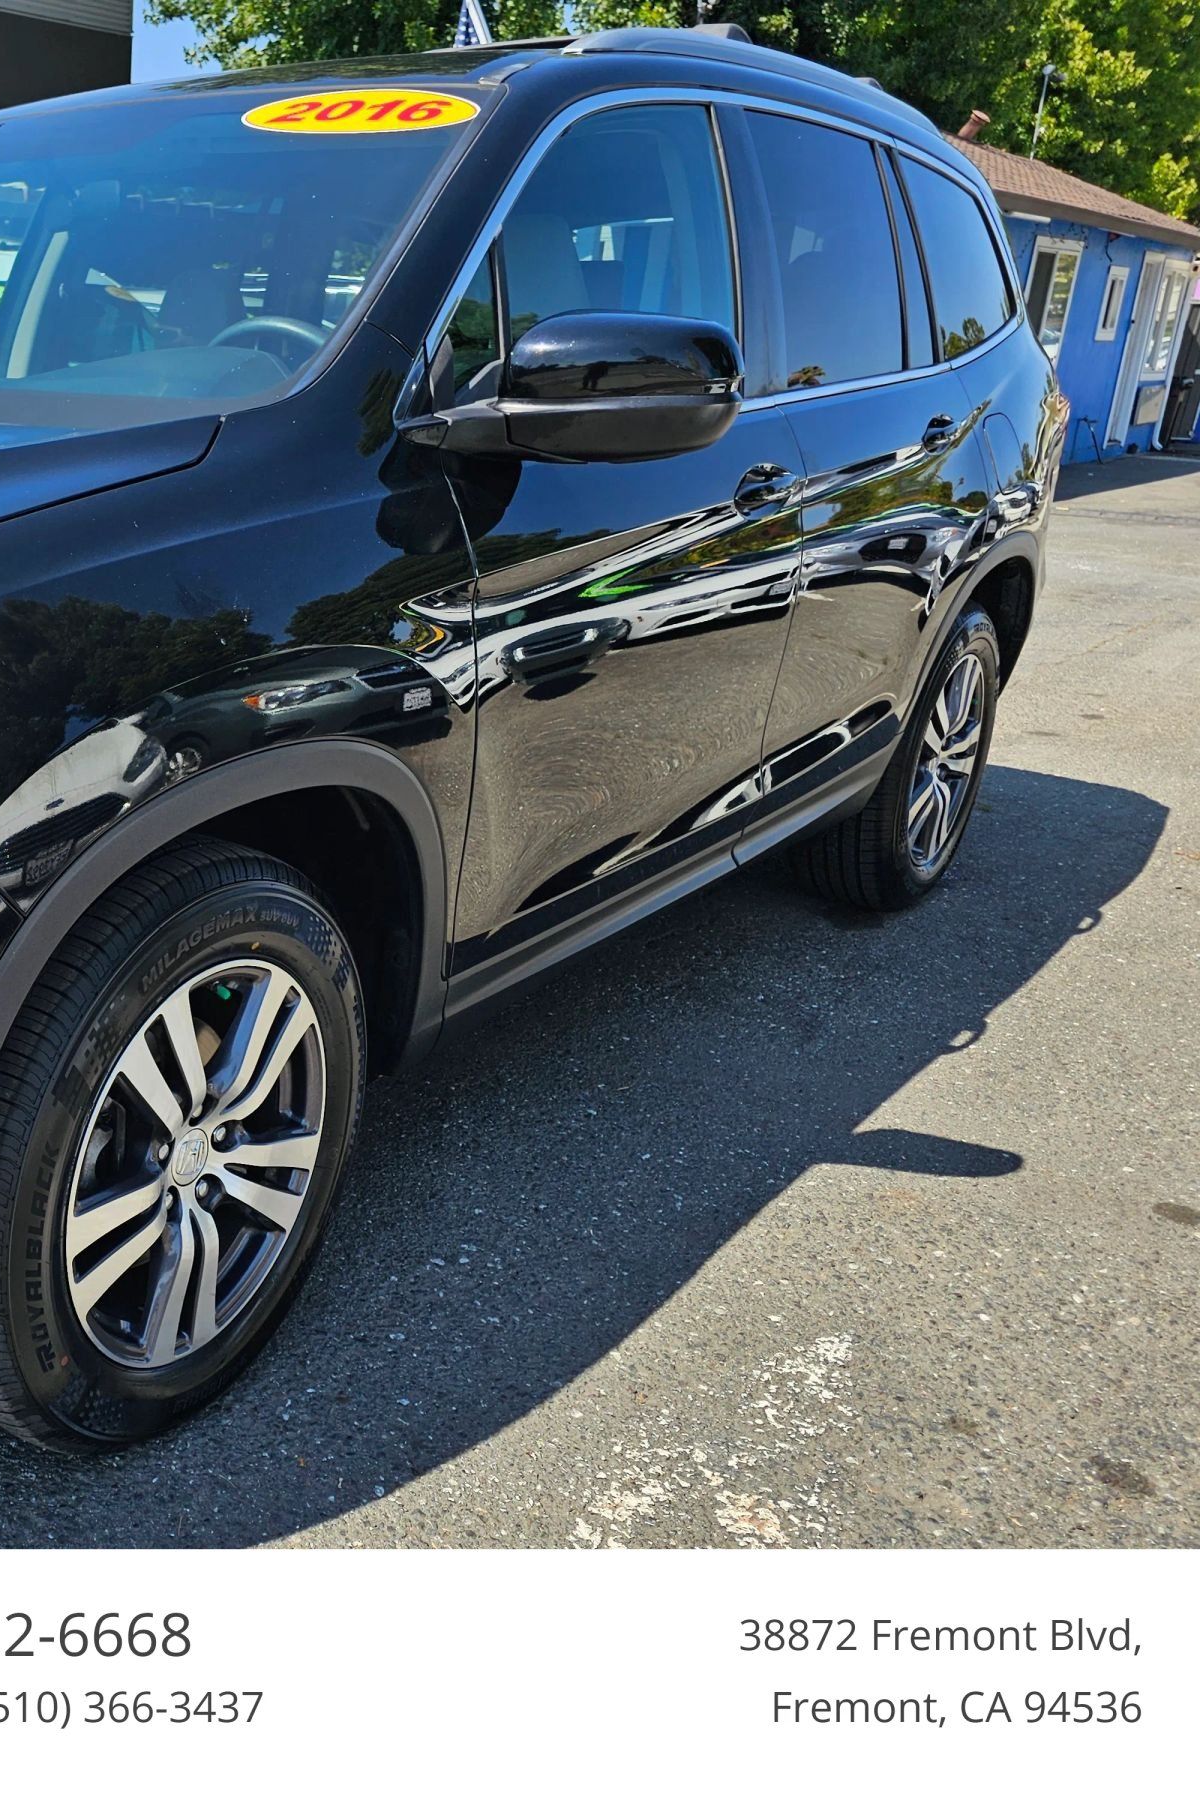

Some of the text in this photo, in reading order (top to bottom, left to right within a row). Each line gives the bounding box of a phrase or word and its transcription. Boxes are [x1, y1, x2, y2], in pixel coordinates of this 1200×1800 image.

[265, 99, 453, 123] 2016
[141, 903, 259, 993] MILAGEMAX
[23, 1142, 60, 1374] ROYALBLACK
